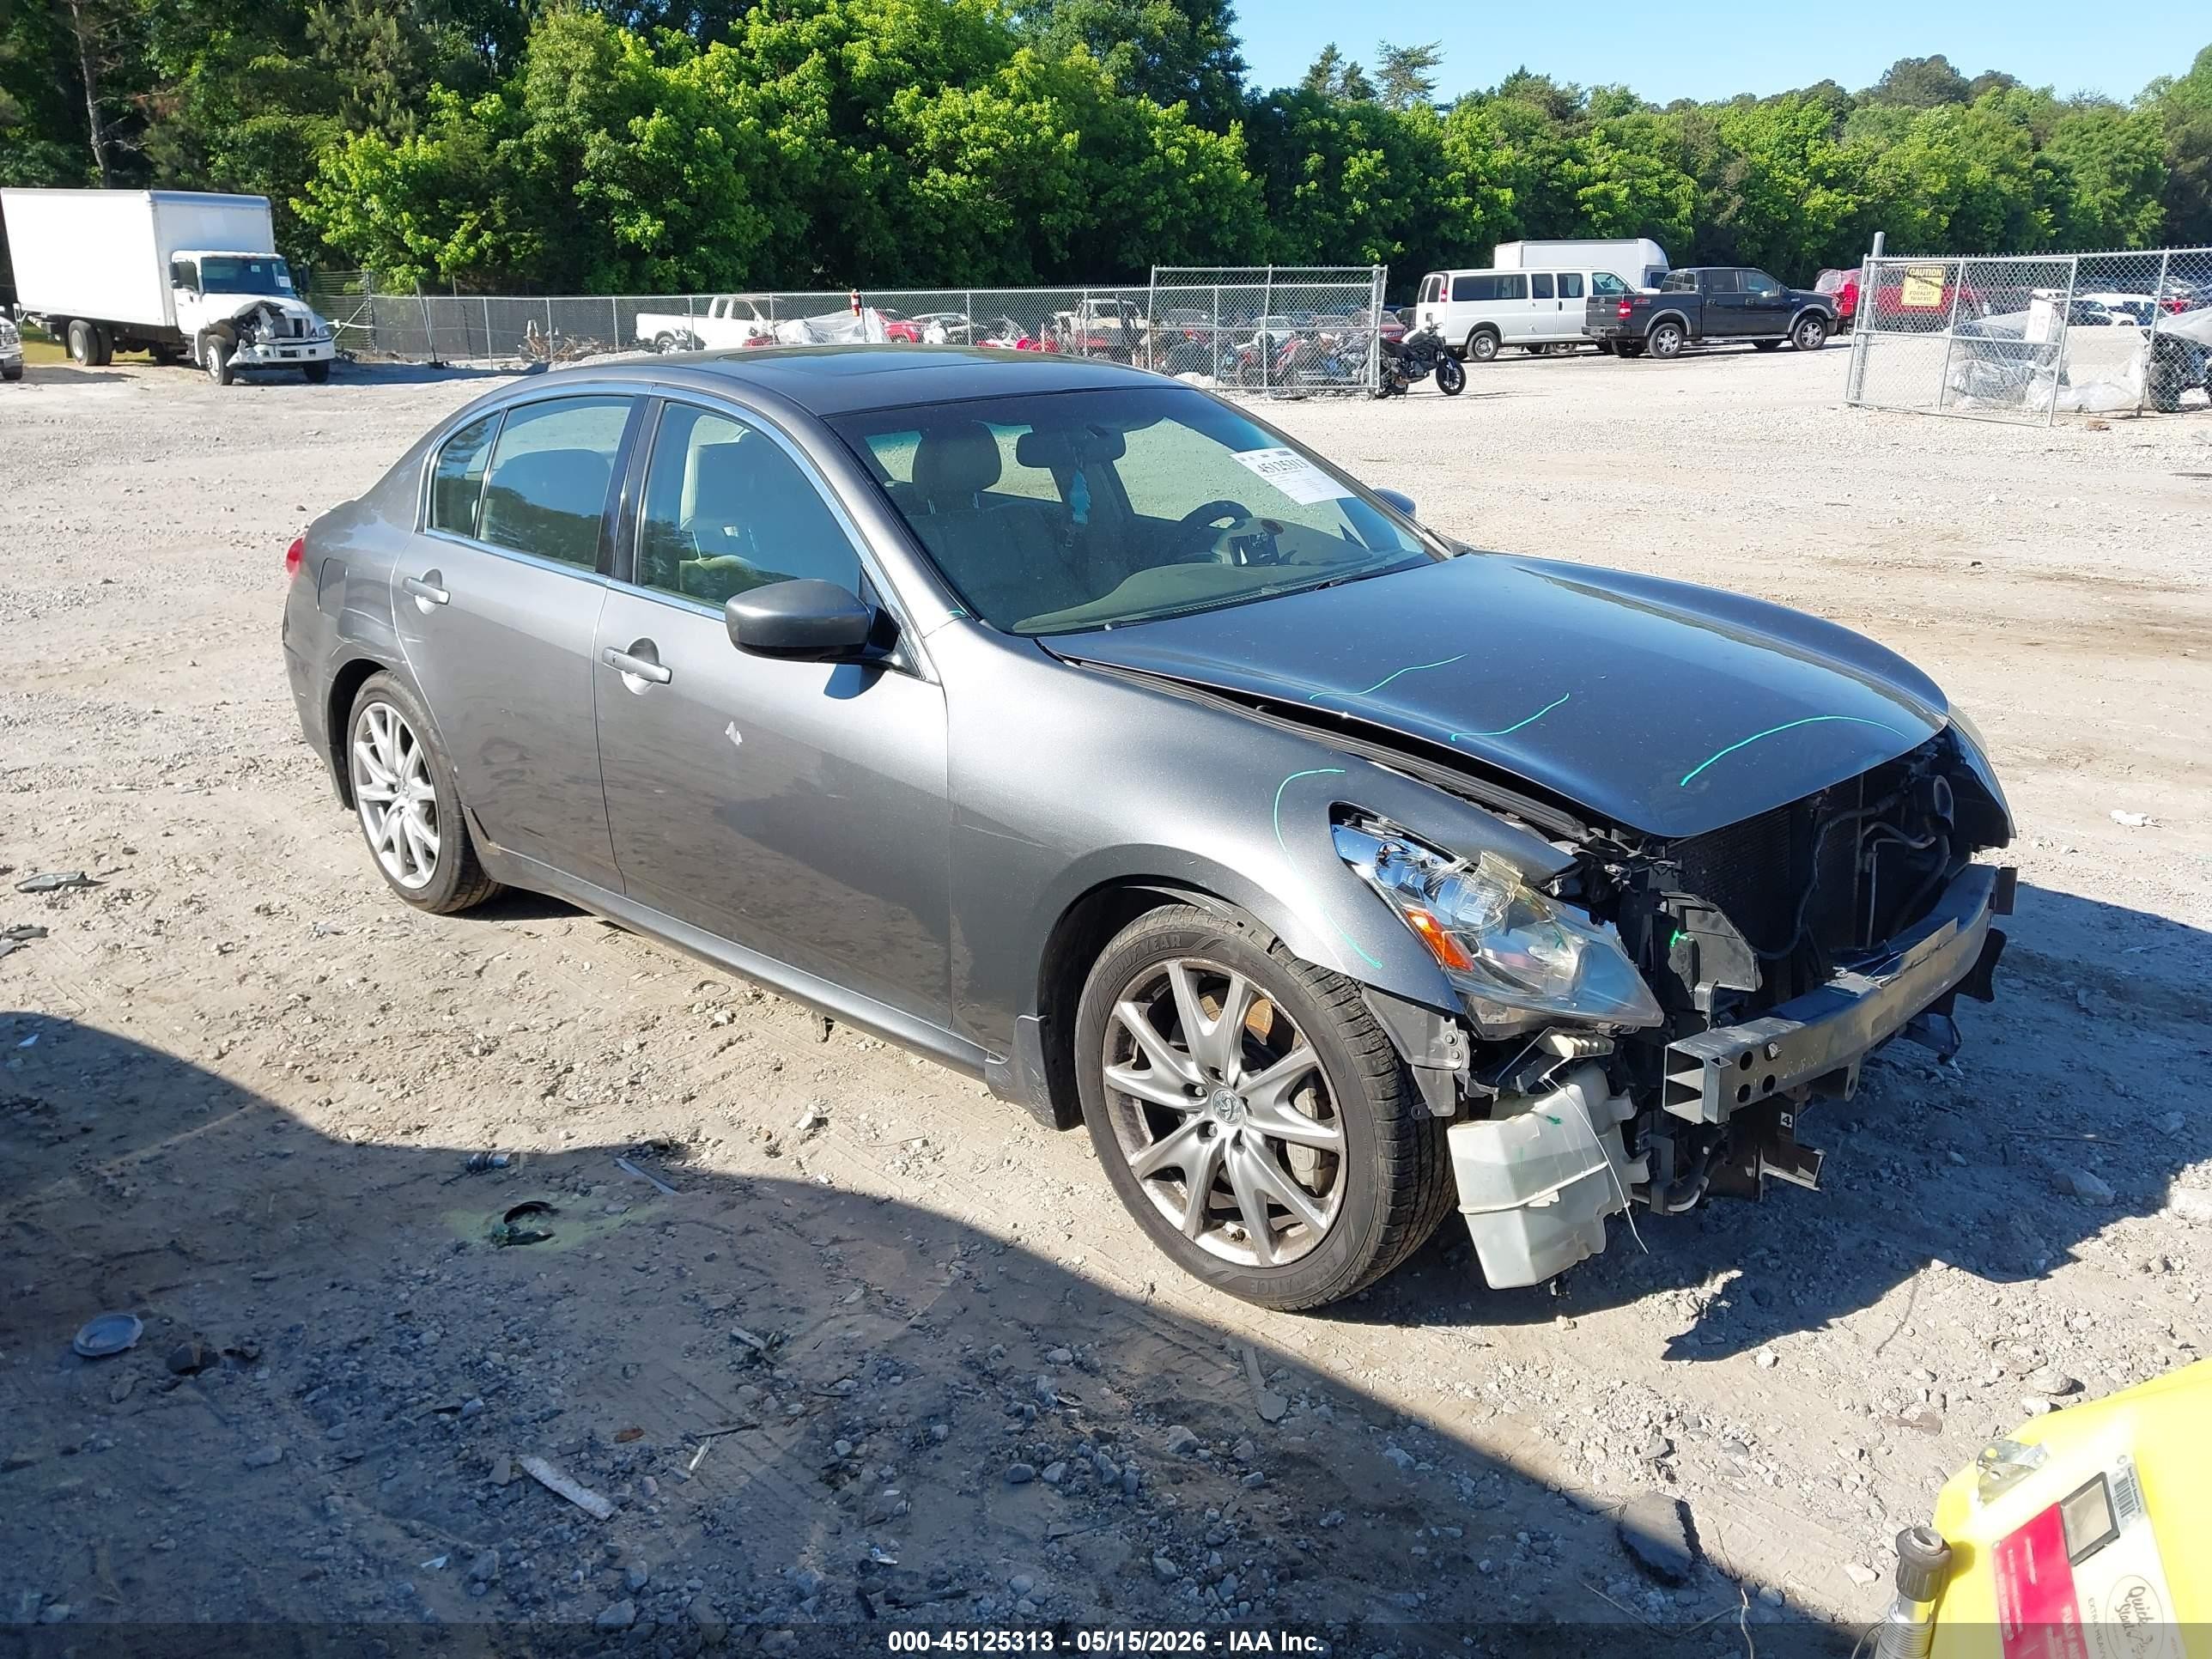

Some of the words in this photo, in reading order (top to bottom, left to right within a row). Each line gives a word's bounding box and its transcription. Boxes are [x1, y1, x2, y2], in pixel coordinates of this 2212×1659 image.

[1909, 268, 1943, 276] CAUTION
[1256, 458, 1310, 474] 45125313
[1782, 1115, 1792, 1126] 4
[2124, 1586, 2154, 1628] Quick
